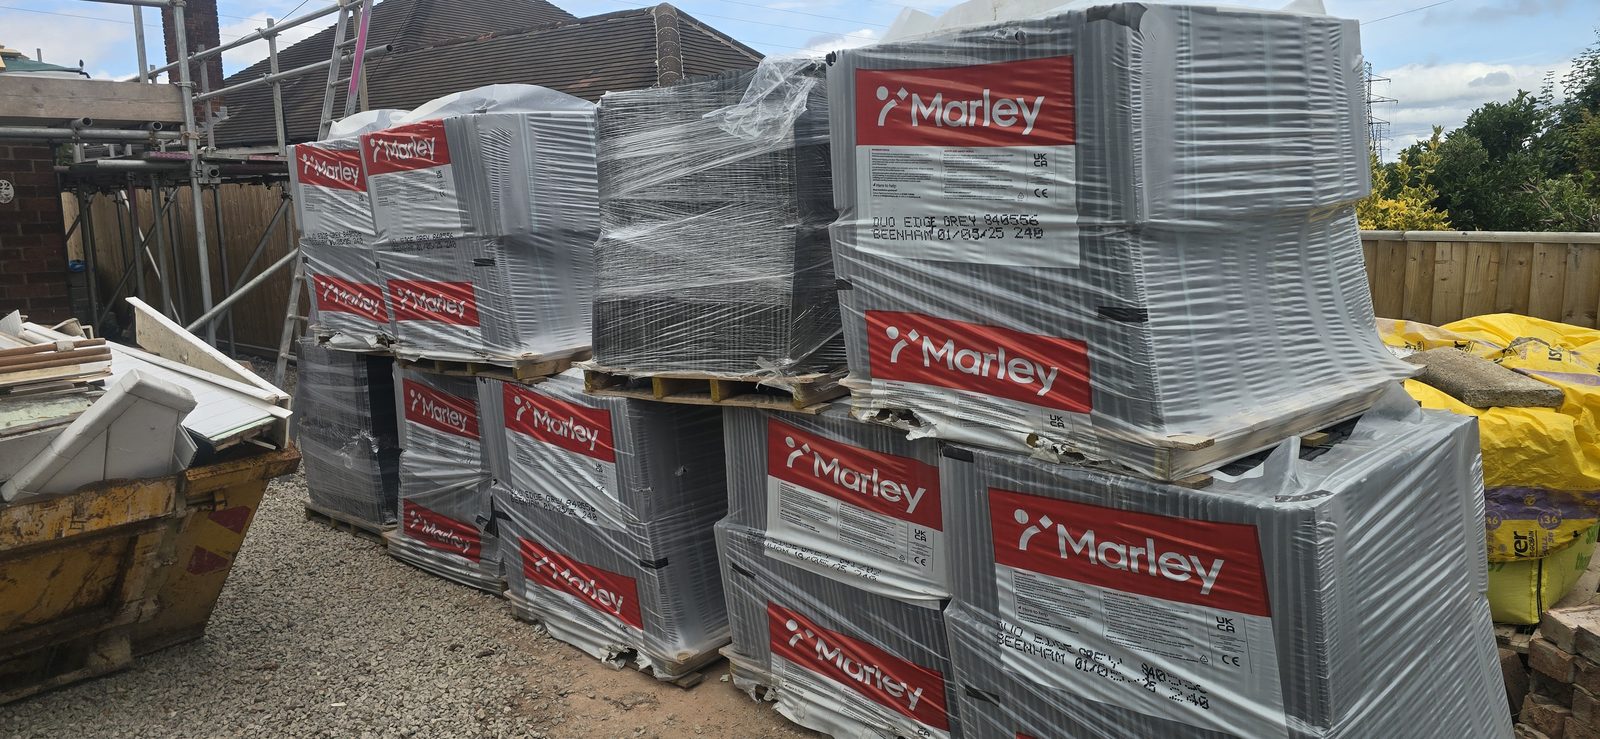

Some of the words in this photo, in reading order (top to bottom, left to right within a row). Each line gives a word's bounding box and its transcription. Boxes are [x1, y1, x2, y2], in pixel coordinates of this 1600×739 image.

[911, 89, 1045, 135] Marley
[384, 136, 435, 161] Marley
[315, 158, 359, 184] Marley
[872, 216, 896, 228] DUO
[944, 215, 977, 227] GREY
[983, 213, 1040, 226] 840556
[872, 229, 934, 241] BEENHAM
[412, 292, 465, 318] Marley
[922, 335, 1059, 397] Marley
[422, 398, 467, 432] Marley
[1050, 414, 1063, 422] UK
[533, 409, 599, 450] Marley
[813, 452, 926, 513] Marley
[914, 528, 927, 537] UK
[1057, 523, 1225, 595] Marley
[1215, 616, 1234, 626] UK
[1216, 624, 1236, 634] CA
[996, 631, 1066, 665] BEENHAM
[815, 638, 923, 711] Marley
